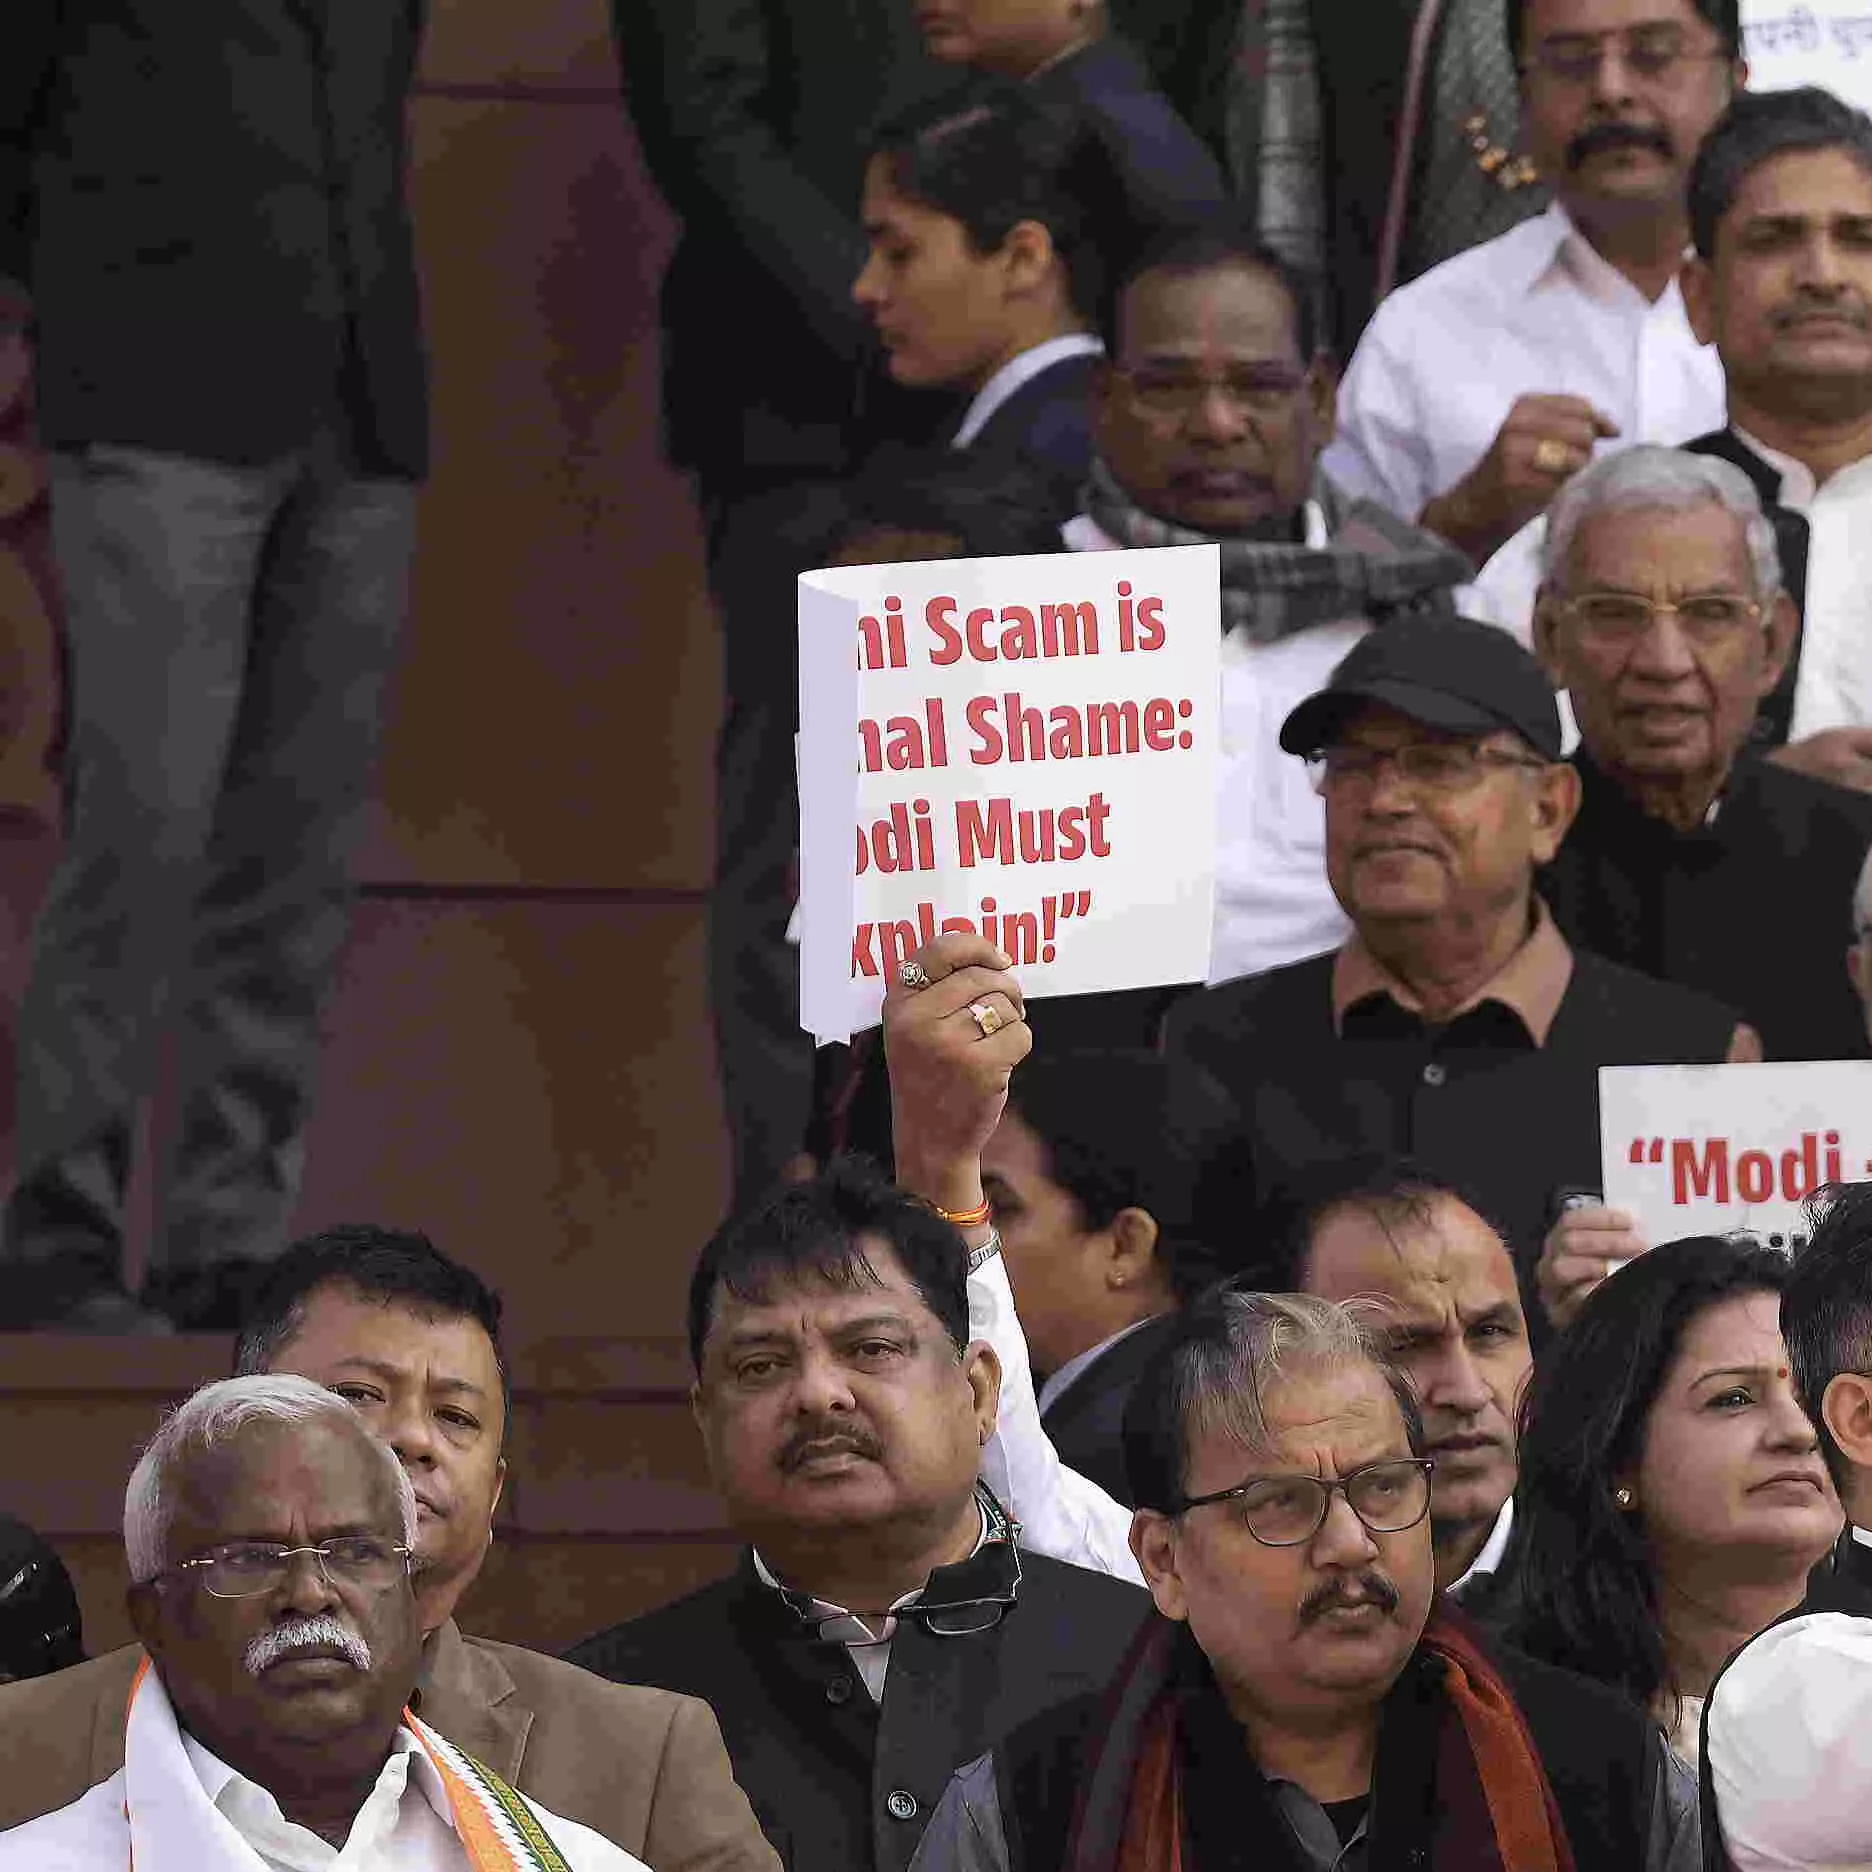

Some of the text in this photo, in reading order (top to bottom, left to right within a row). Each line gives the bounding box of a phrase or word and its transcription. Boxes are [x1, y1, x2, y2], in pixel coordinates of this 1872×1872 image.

[925, 595, 1100, 667] Scam
[1117, 580, 1167, 653] is
[965, 692, 1194, 766] Shame:
[954, 792, 1111, 868] Must
[1629, 1132, 1842, 1205] “Modi
